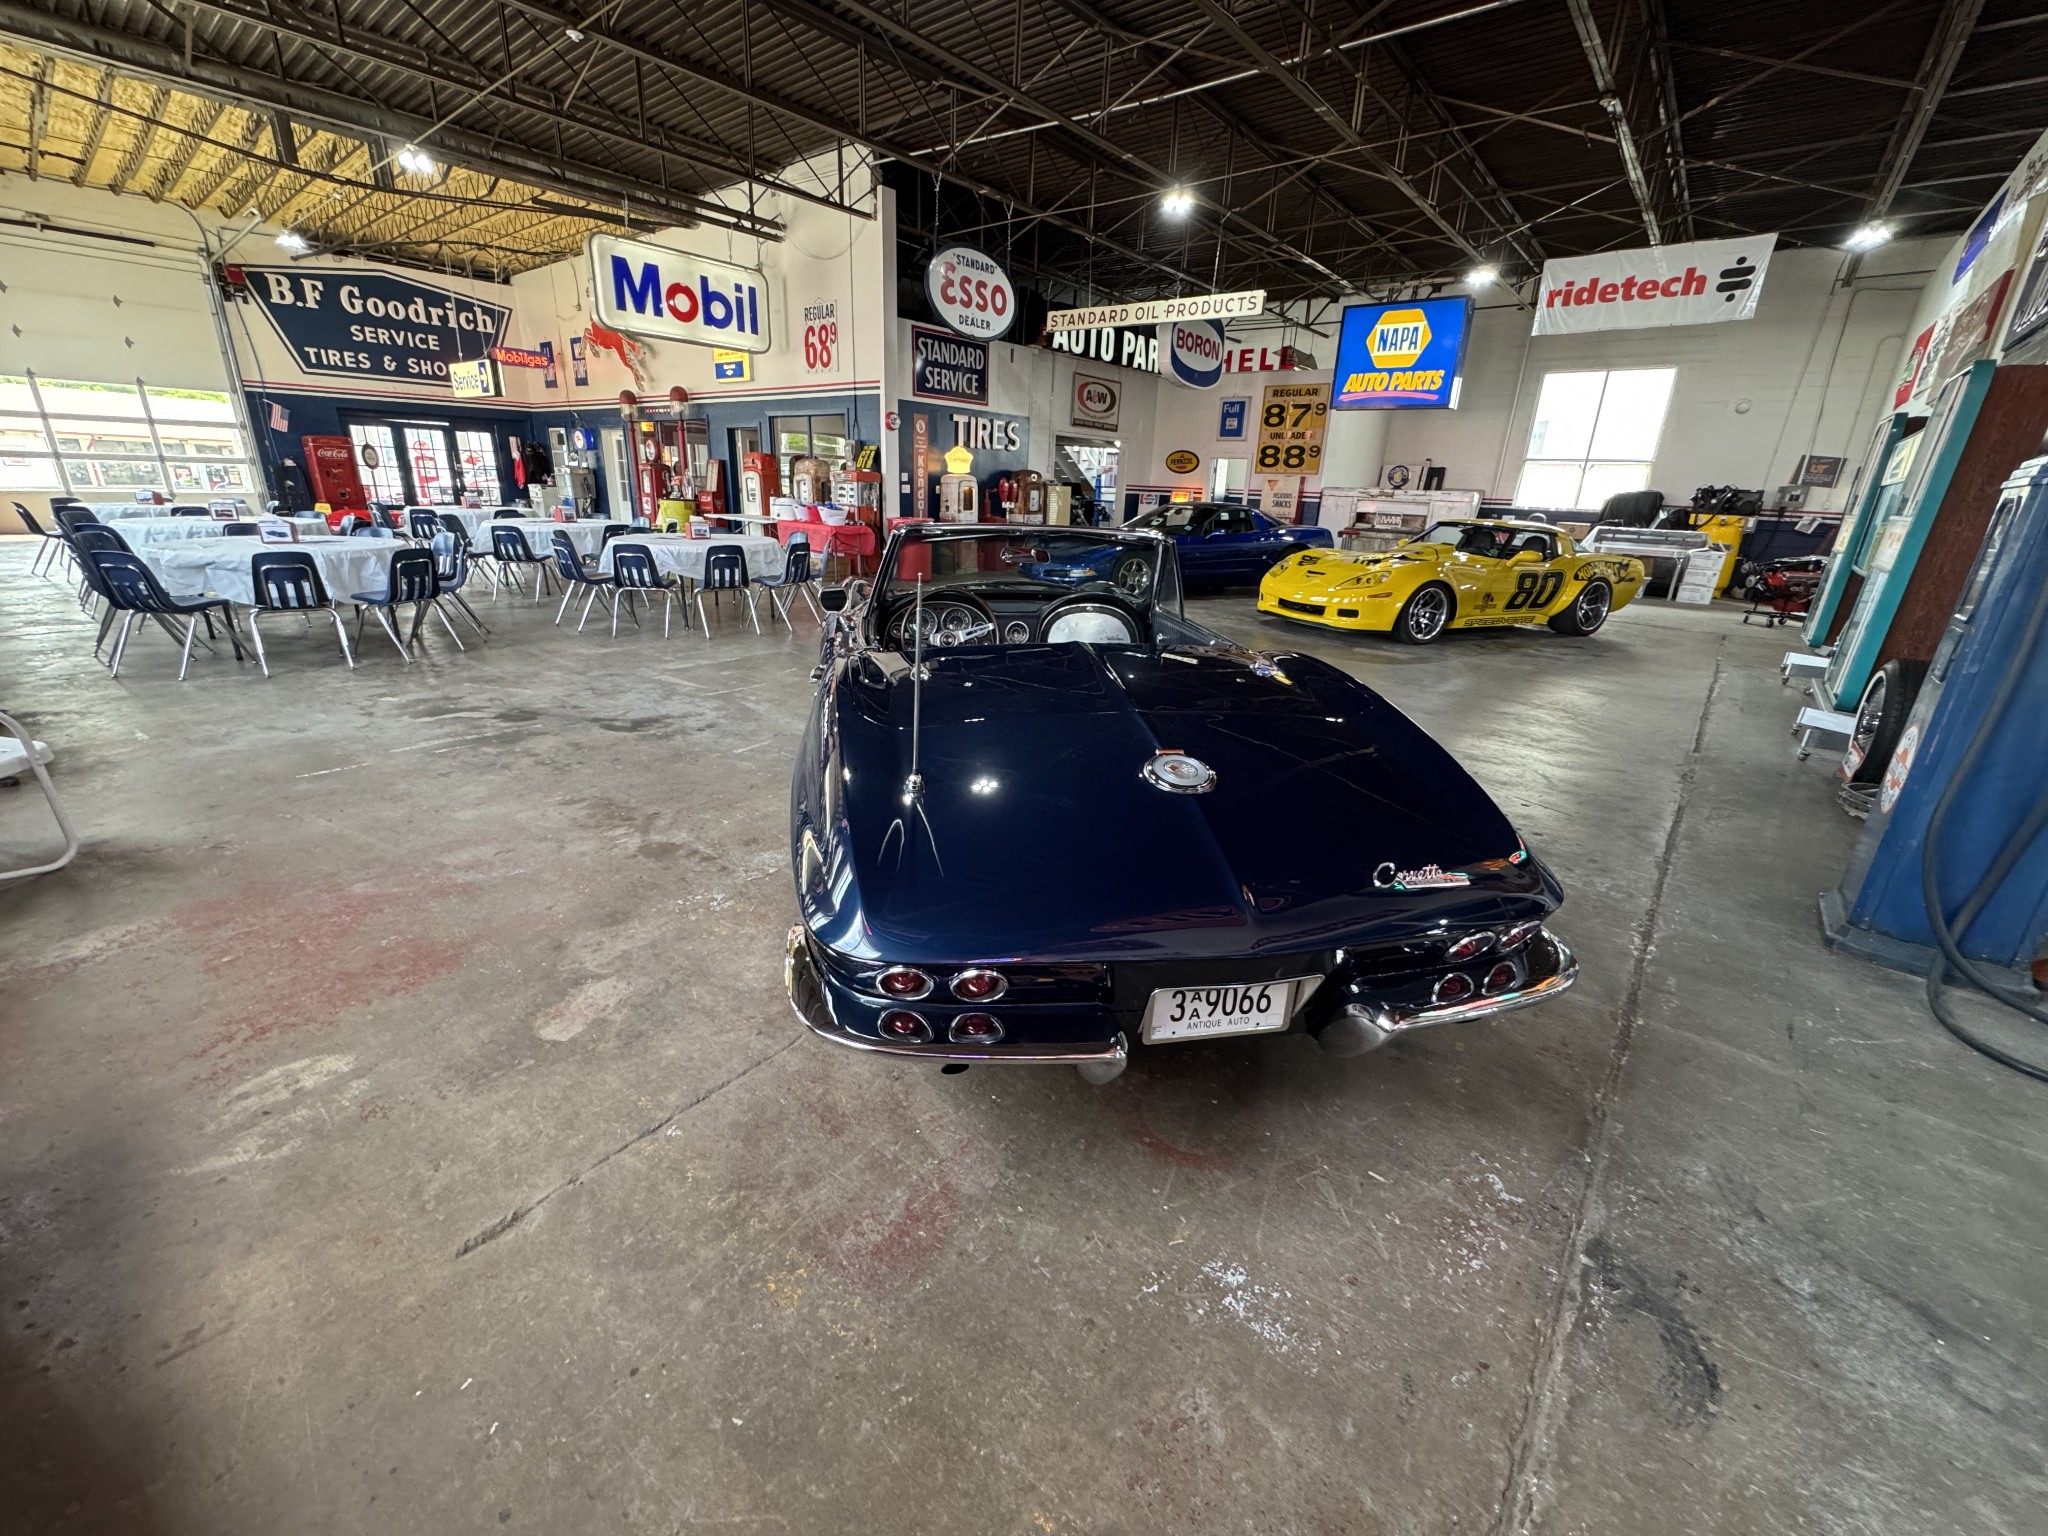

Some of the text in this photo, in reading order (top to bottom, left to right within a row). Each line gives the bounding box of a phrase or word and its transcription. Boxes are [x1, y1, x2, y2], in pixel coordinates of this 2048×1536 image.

[610, 254, 759, 335] Mobil
[941, 262, 1007, 316] ESSO
[1546, 267, 1707, 308] ridetech
[340, 285, 496, 333] Goodrich
[805, 303, 835, 322] REGULAR
[1050, 295, 1257, 328] STANDARD OIL PRODUCTS
[958, 314, 991, 331] DEALER
[351, 325, 440, 350] SERVICE
[1176, 328, 1220, 361] BORON
[1377, 325, 1420, 353] NAPA
[304, 347, 450, 377] TIRES & SHO
[495, 349, 548, 367] Mobilgas
[918, 337, 985, 370] STANDARD
[453, 371, 480, 391] Service
[925, 366, 979, 395] SERVICE
[1272, 388, 1319, 397] REGULAR
[1344, 369, 1445, 393] AUTO PARTS
[1086, 390, 1108, 404] A&W
[1223, 404, 1240, 413] Full
[952, 414, 1021, 451] TIRES
[317, 448, 349, 458] Coca-Cola
[1272, 500, 1292, 508] SNACKS
[1502, 570, 1565, 612] 80
[1373, 862, 1442, 888] Corvette
[1186, 1016, 1250, 1030] ANTIQUE AUTO
